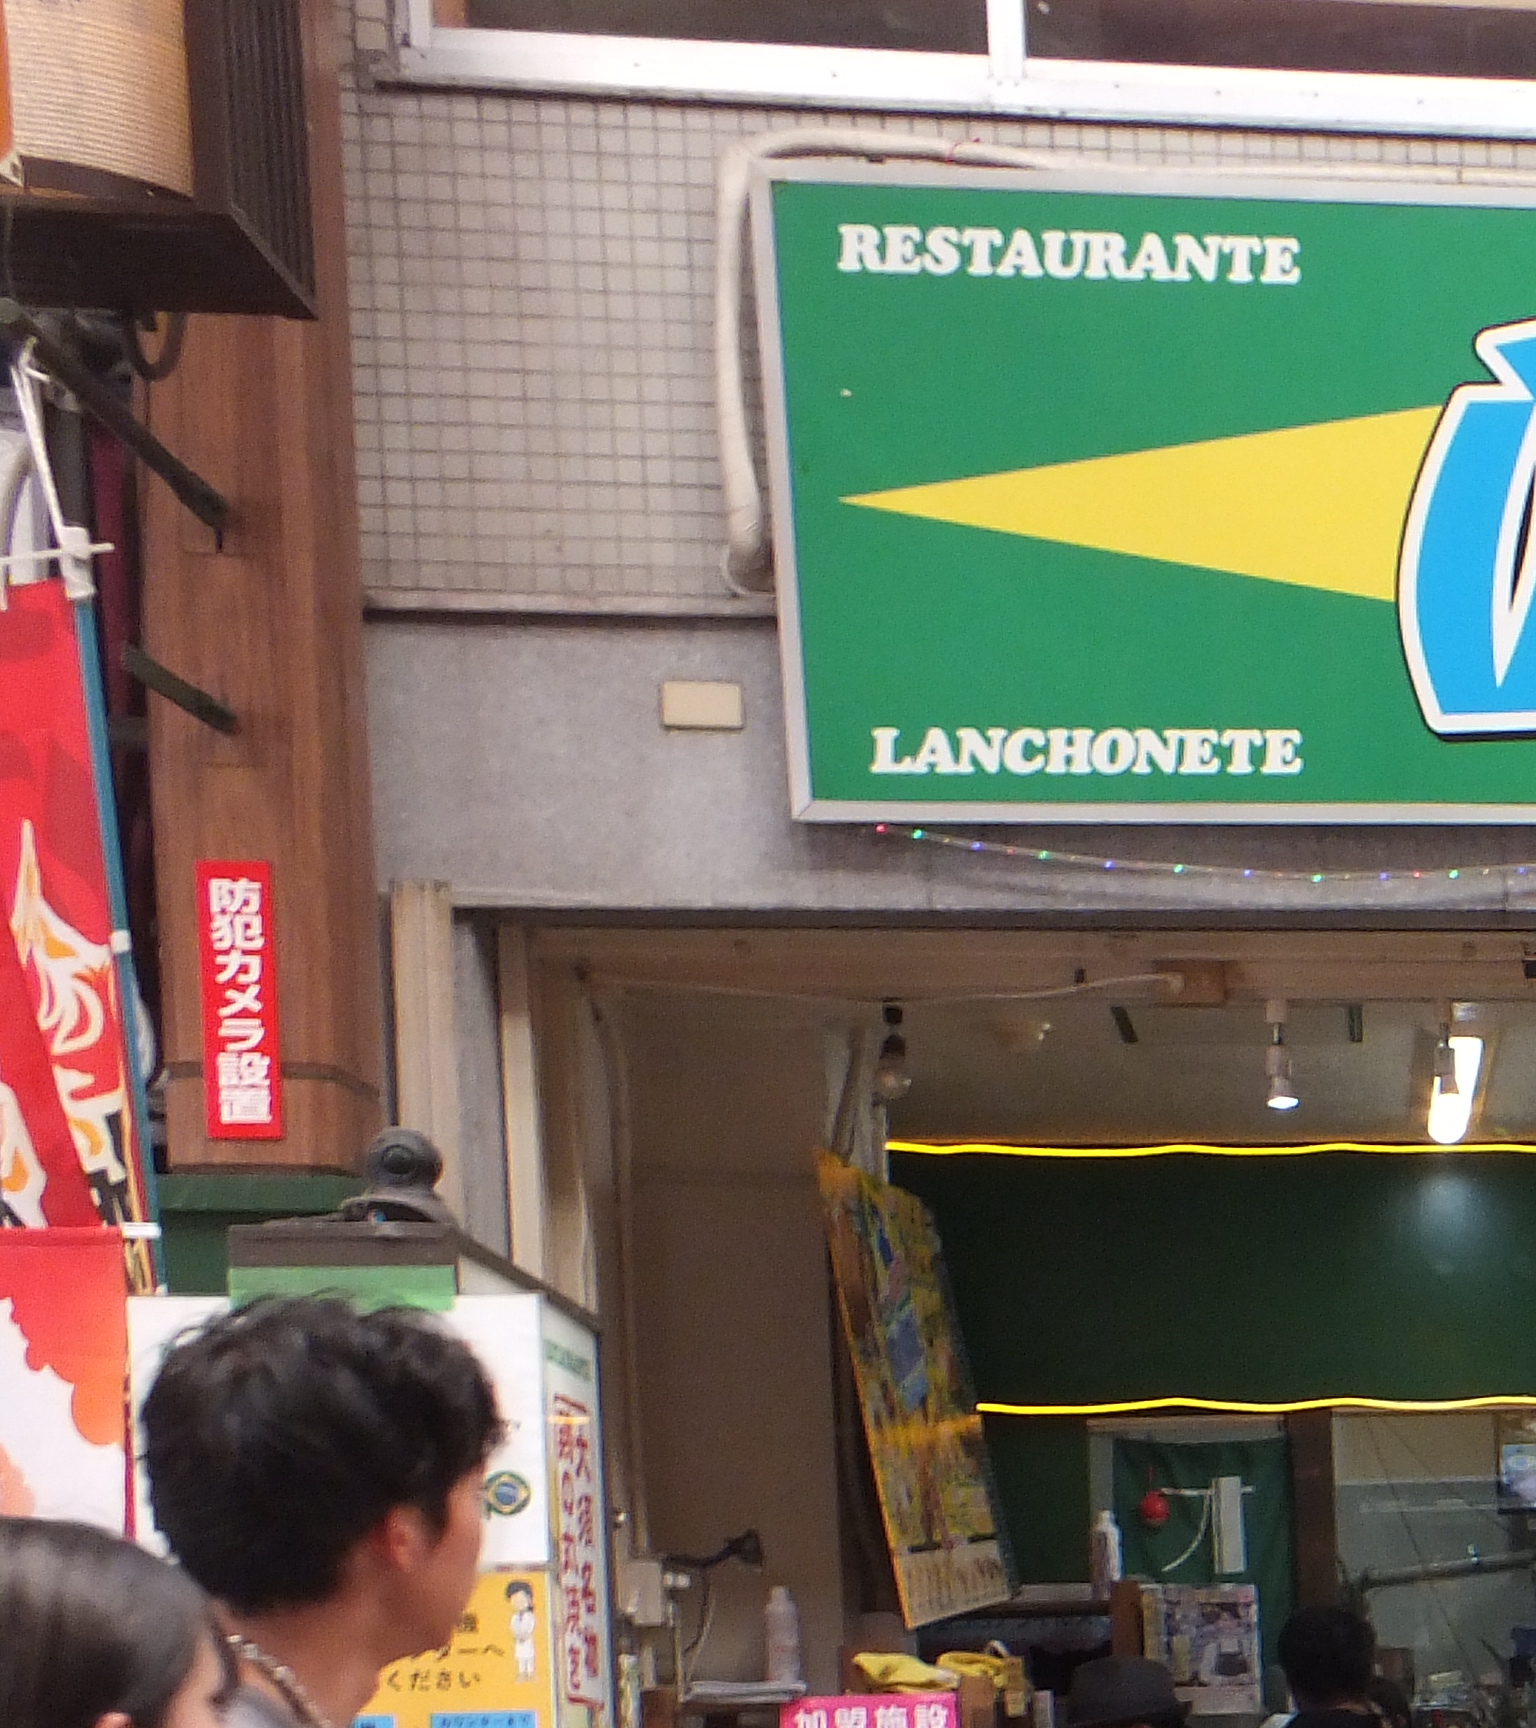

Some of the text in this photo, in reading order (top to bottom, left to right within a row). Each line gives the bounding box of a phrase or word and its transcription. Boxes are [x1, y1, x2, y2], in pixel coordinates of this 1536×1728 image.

[837, 224, 1300, 284] RESTAURANTE
[870, 727, 1304, 775] LANCHONETE
[208, 877, 272, 1125] 防犯カメラ設置
